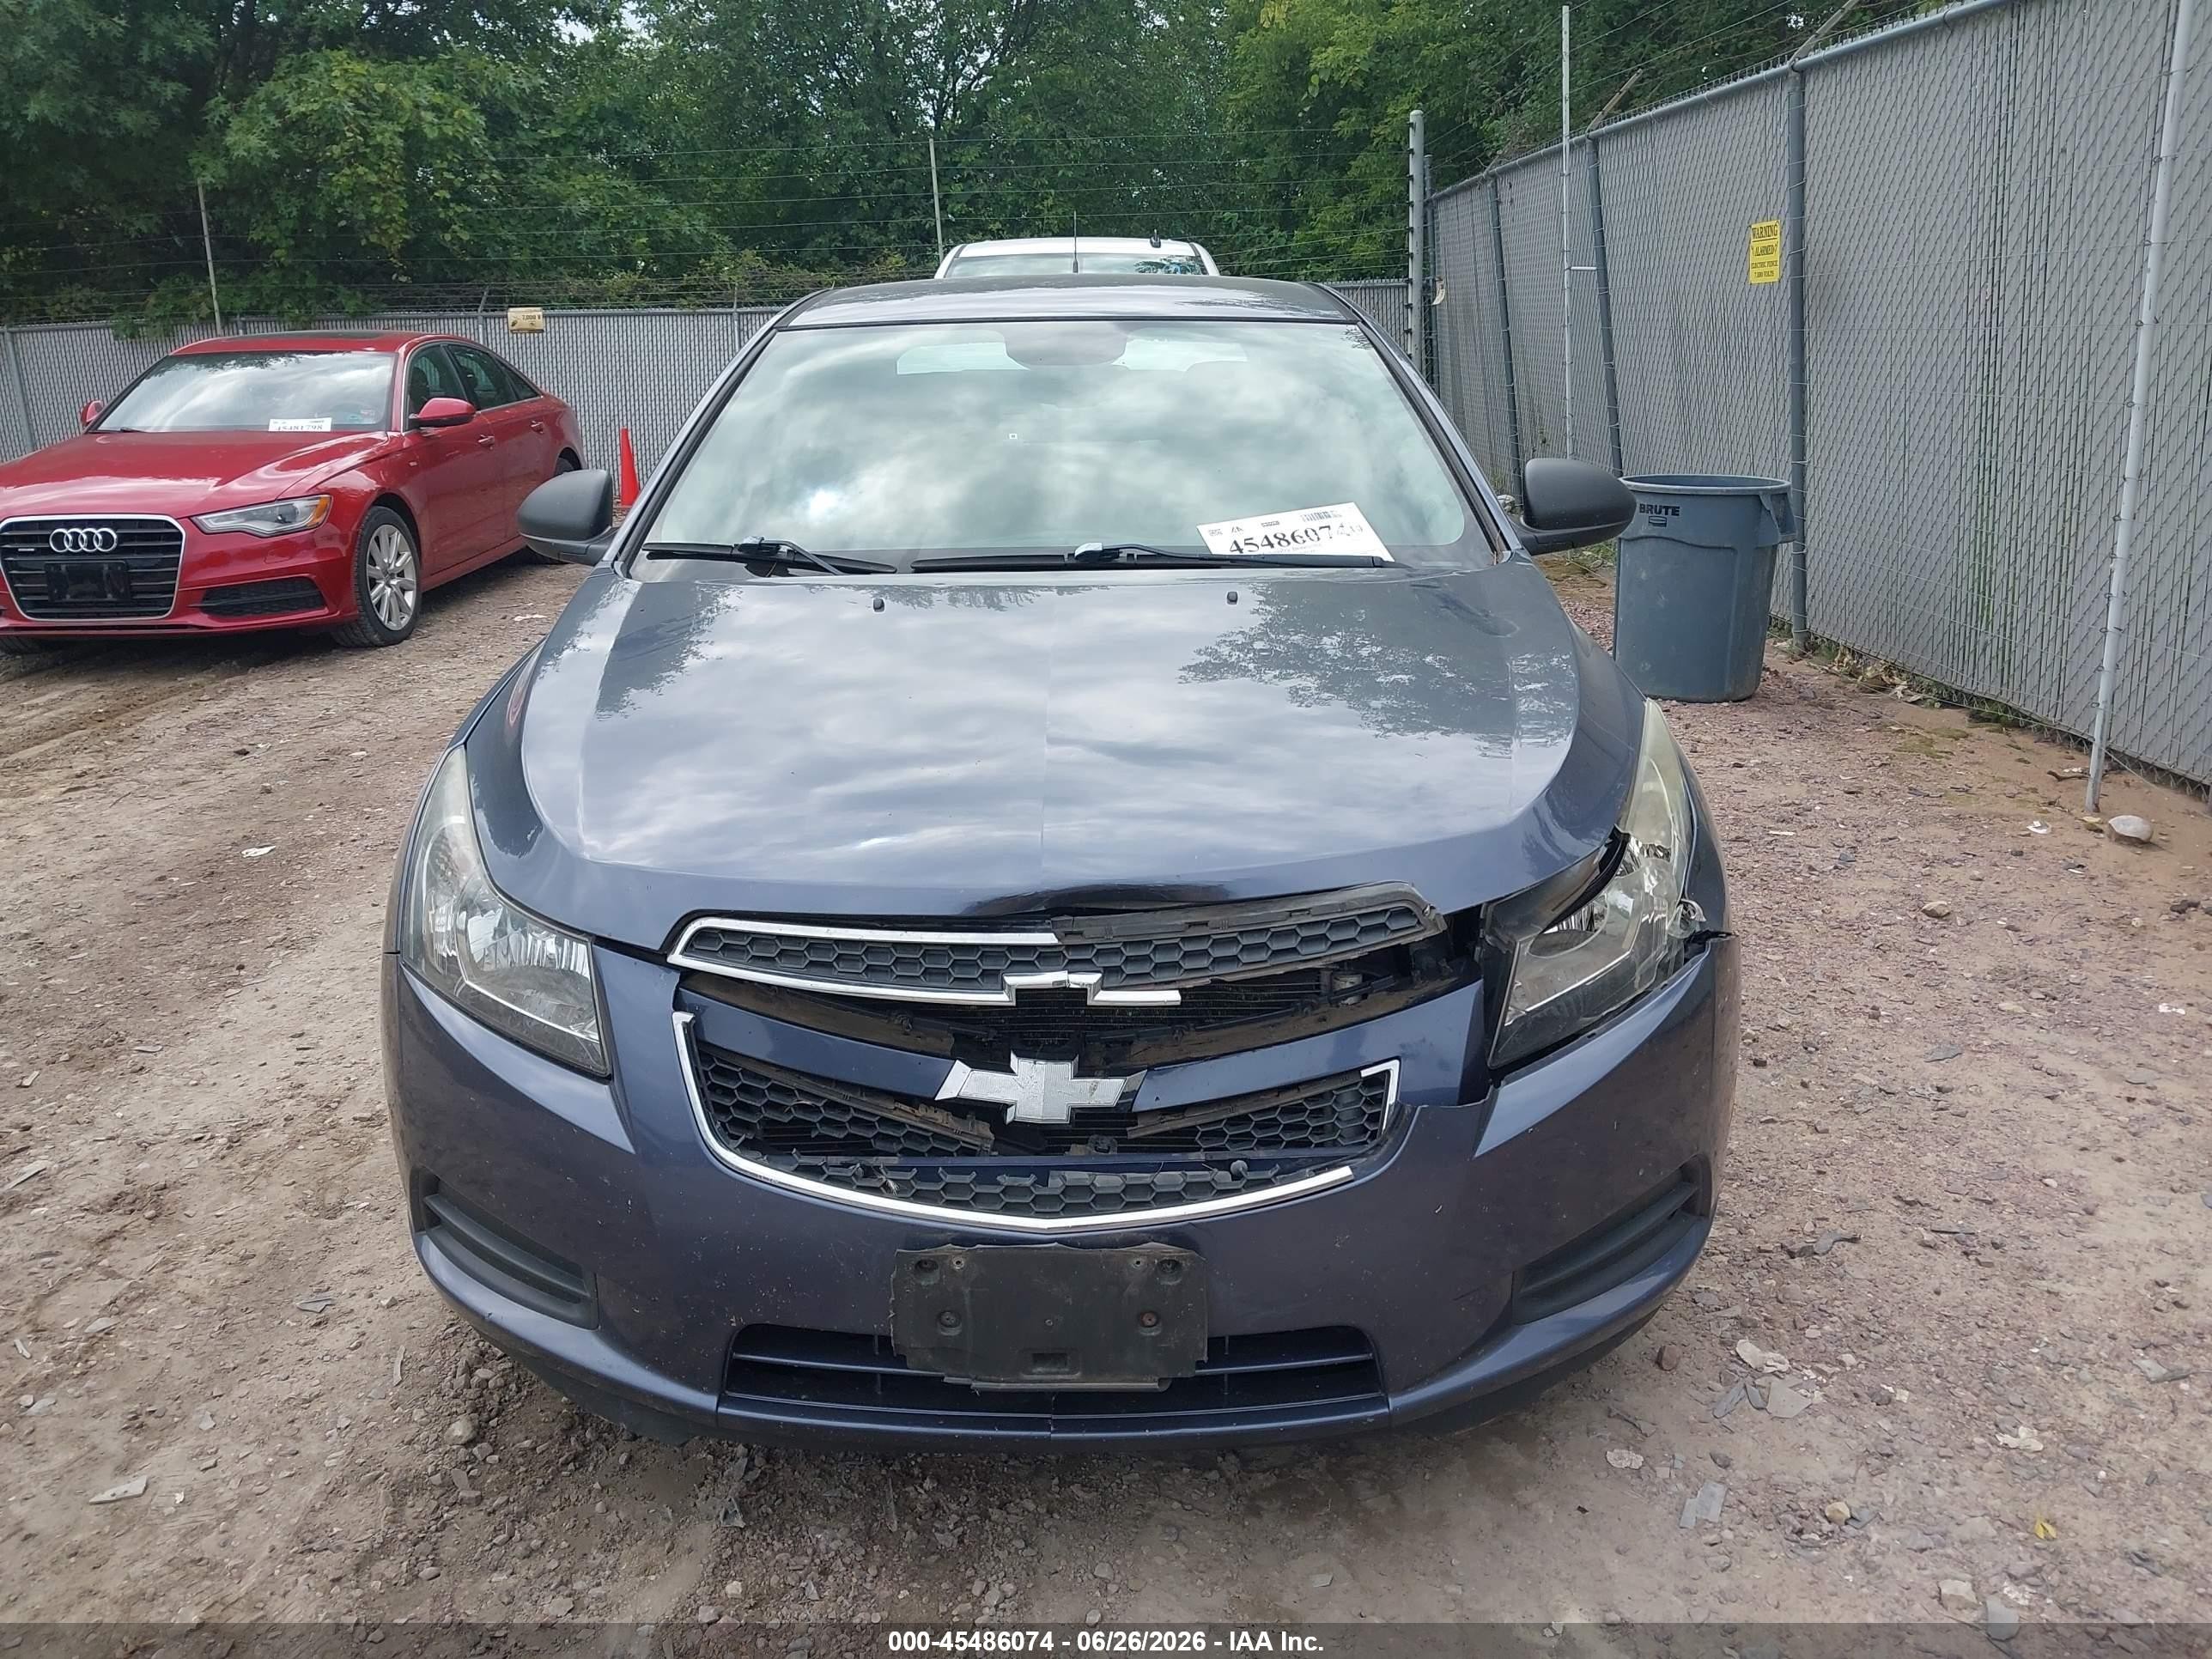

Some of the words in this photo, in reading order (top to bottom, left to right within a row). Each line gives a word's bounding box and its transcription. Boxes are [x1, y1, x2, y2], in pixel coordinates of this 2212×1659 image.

[1752, 225, 1778, 239] WARNING
[1755, 245, 1775, 256] ALARMED
[1639, 503, 1680, 516] BRUTE
